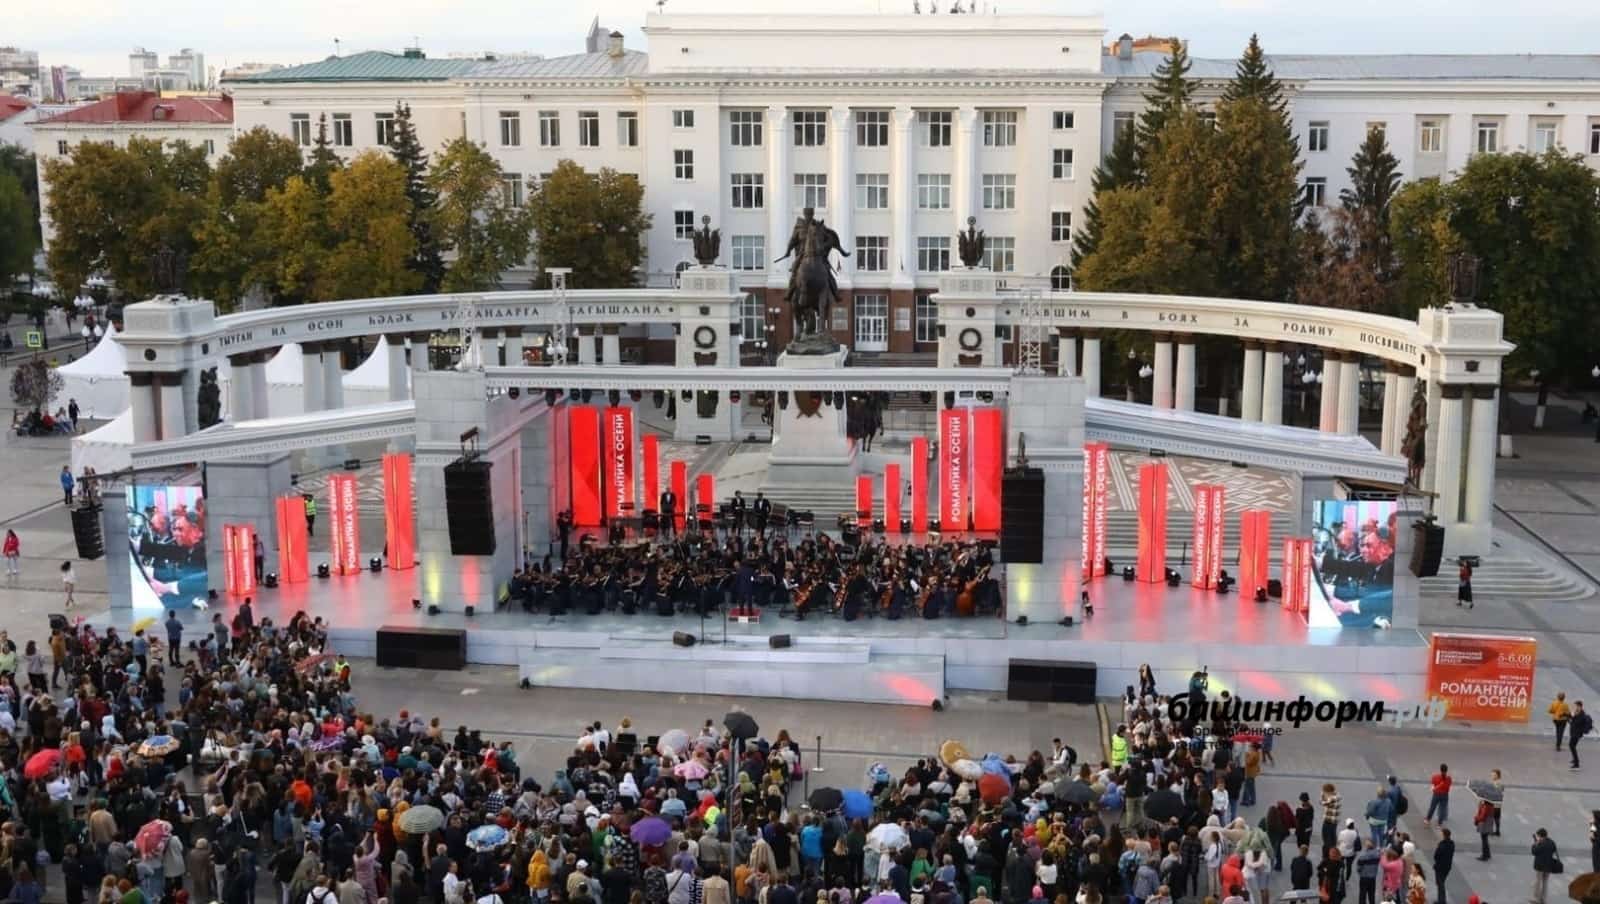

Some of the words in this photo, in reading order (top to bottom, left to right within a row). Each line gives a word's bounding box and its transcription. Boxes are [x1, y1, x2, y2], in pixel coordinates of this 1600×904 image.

[1121, 310, 1129, 320] В
[1158, 312, 1198, 323] БОЯХ
[1234, 317, 1249, 327] ЗА
[1283, 322, 1335, 337] РОДИНУ
[615, 414, 624, 450] ОСЕНИ
[952, 417, 960, 453] ОСЕНИ
[952, 457, 960, 522] РОМАНТИКА
[1440, 682, 1528, 697] РОМАНТИКА
[1477, 695, 1527, 708] ОСЕНИ
